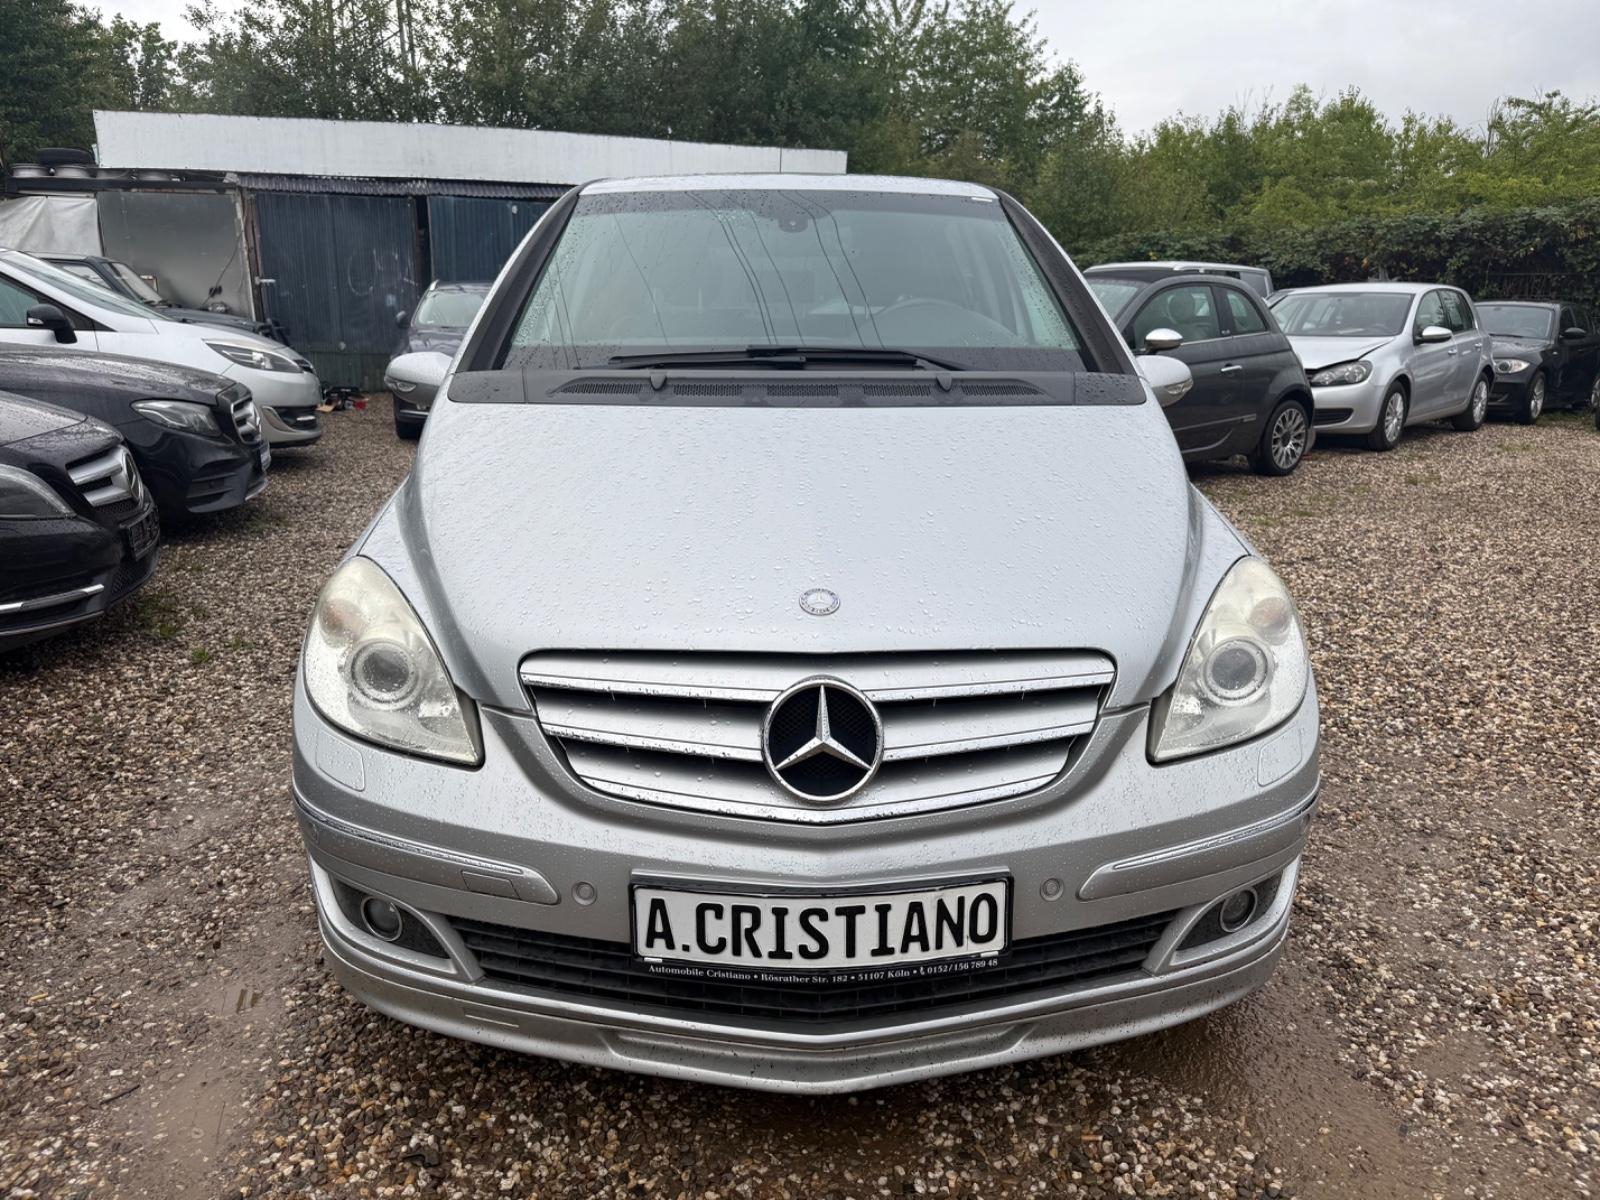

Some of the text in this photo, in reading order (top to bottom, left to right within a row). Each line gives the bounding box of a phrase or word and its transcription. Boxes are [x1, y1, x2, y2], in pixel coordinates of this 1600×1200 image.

[645, 892, 998, 960] A.CRISTIANO
[648, 964, 704, 977] Automobile
[706, 969, 751, 981] Cristiano
[761, 973, 809, 984] Rösrather
[812, 975, 829, 984] Str.
[832, 975, 848, 983] 182
[858, 971, 885, 981] 51107
[887, 969, 910, 979] Köln
[927, 963, 969, 974] 0152/156
[970, 960, 986, 969] 789
